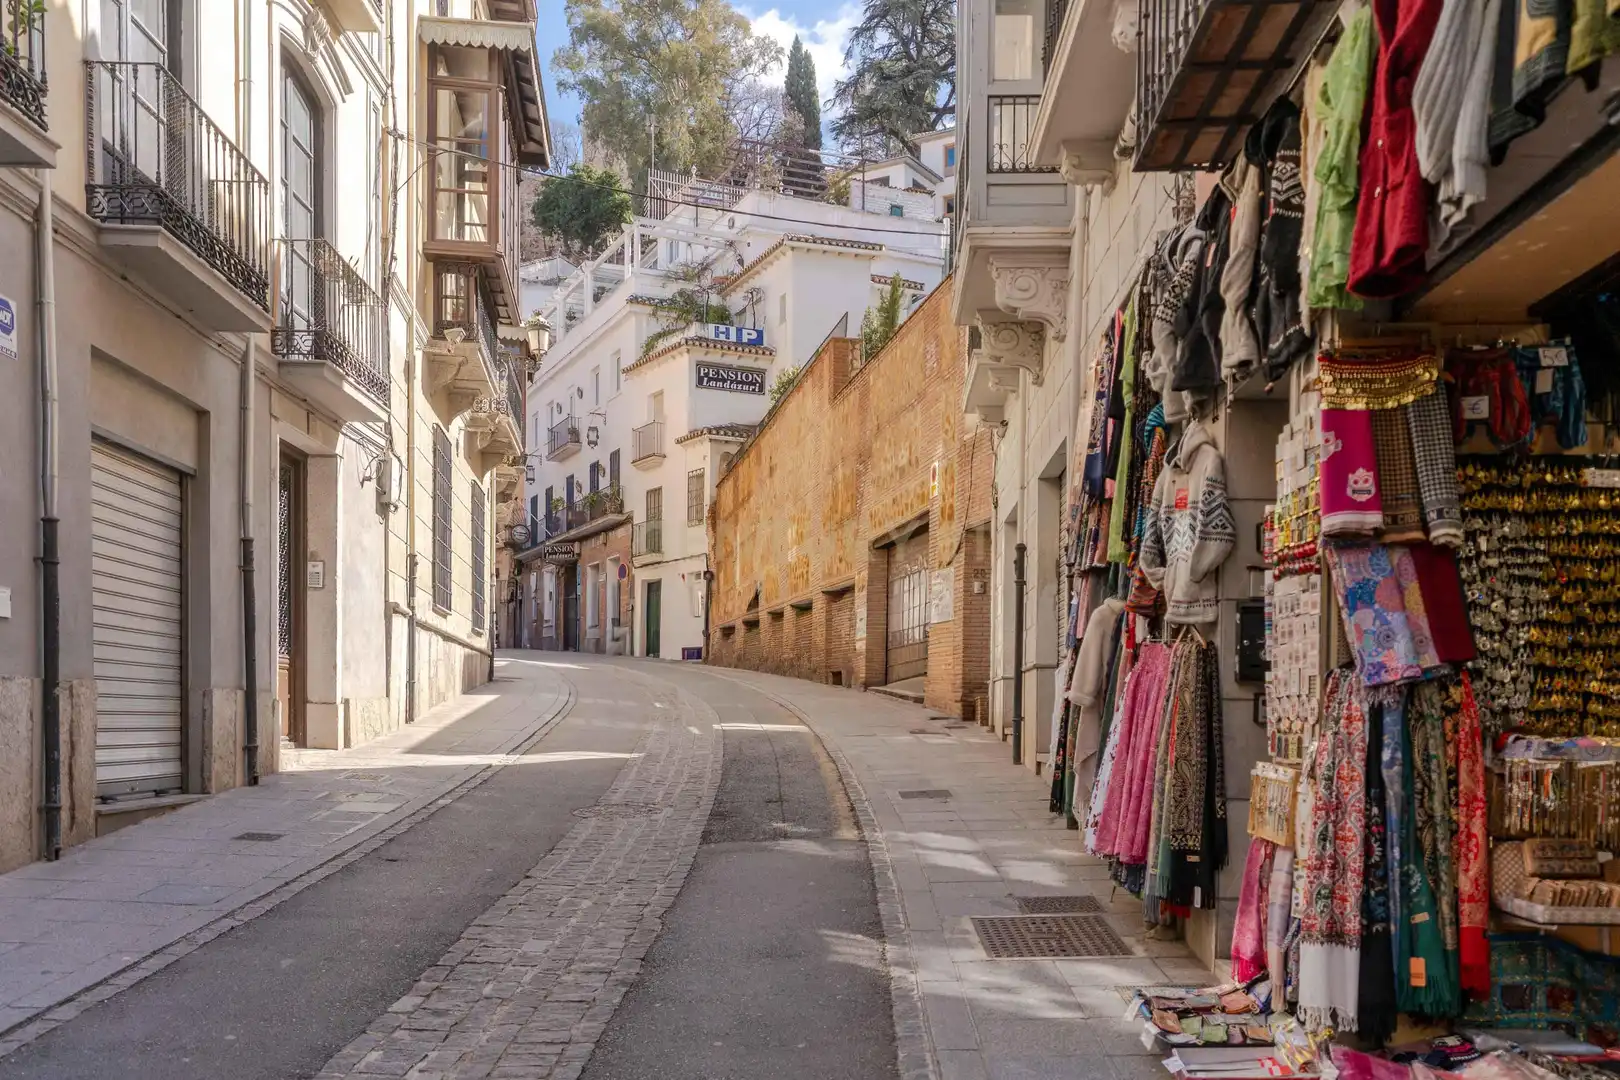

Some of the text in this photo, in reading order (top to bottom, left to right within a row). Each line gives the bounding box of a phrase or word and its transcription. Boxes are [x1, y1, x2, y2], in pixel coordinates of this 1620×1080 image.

[700, 367, 762, 383] PENSION
[702, 377, 760, 392] Landázuri
[544, 545, 574, 553] PENSION
